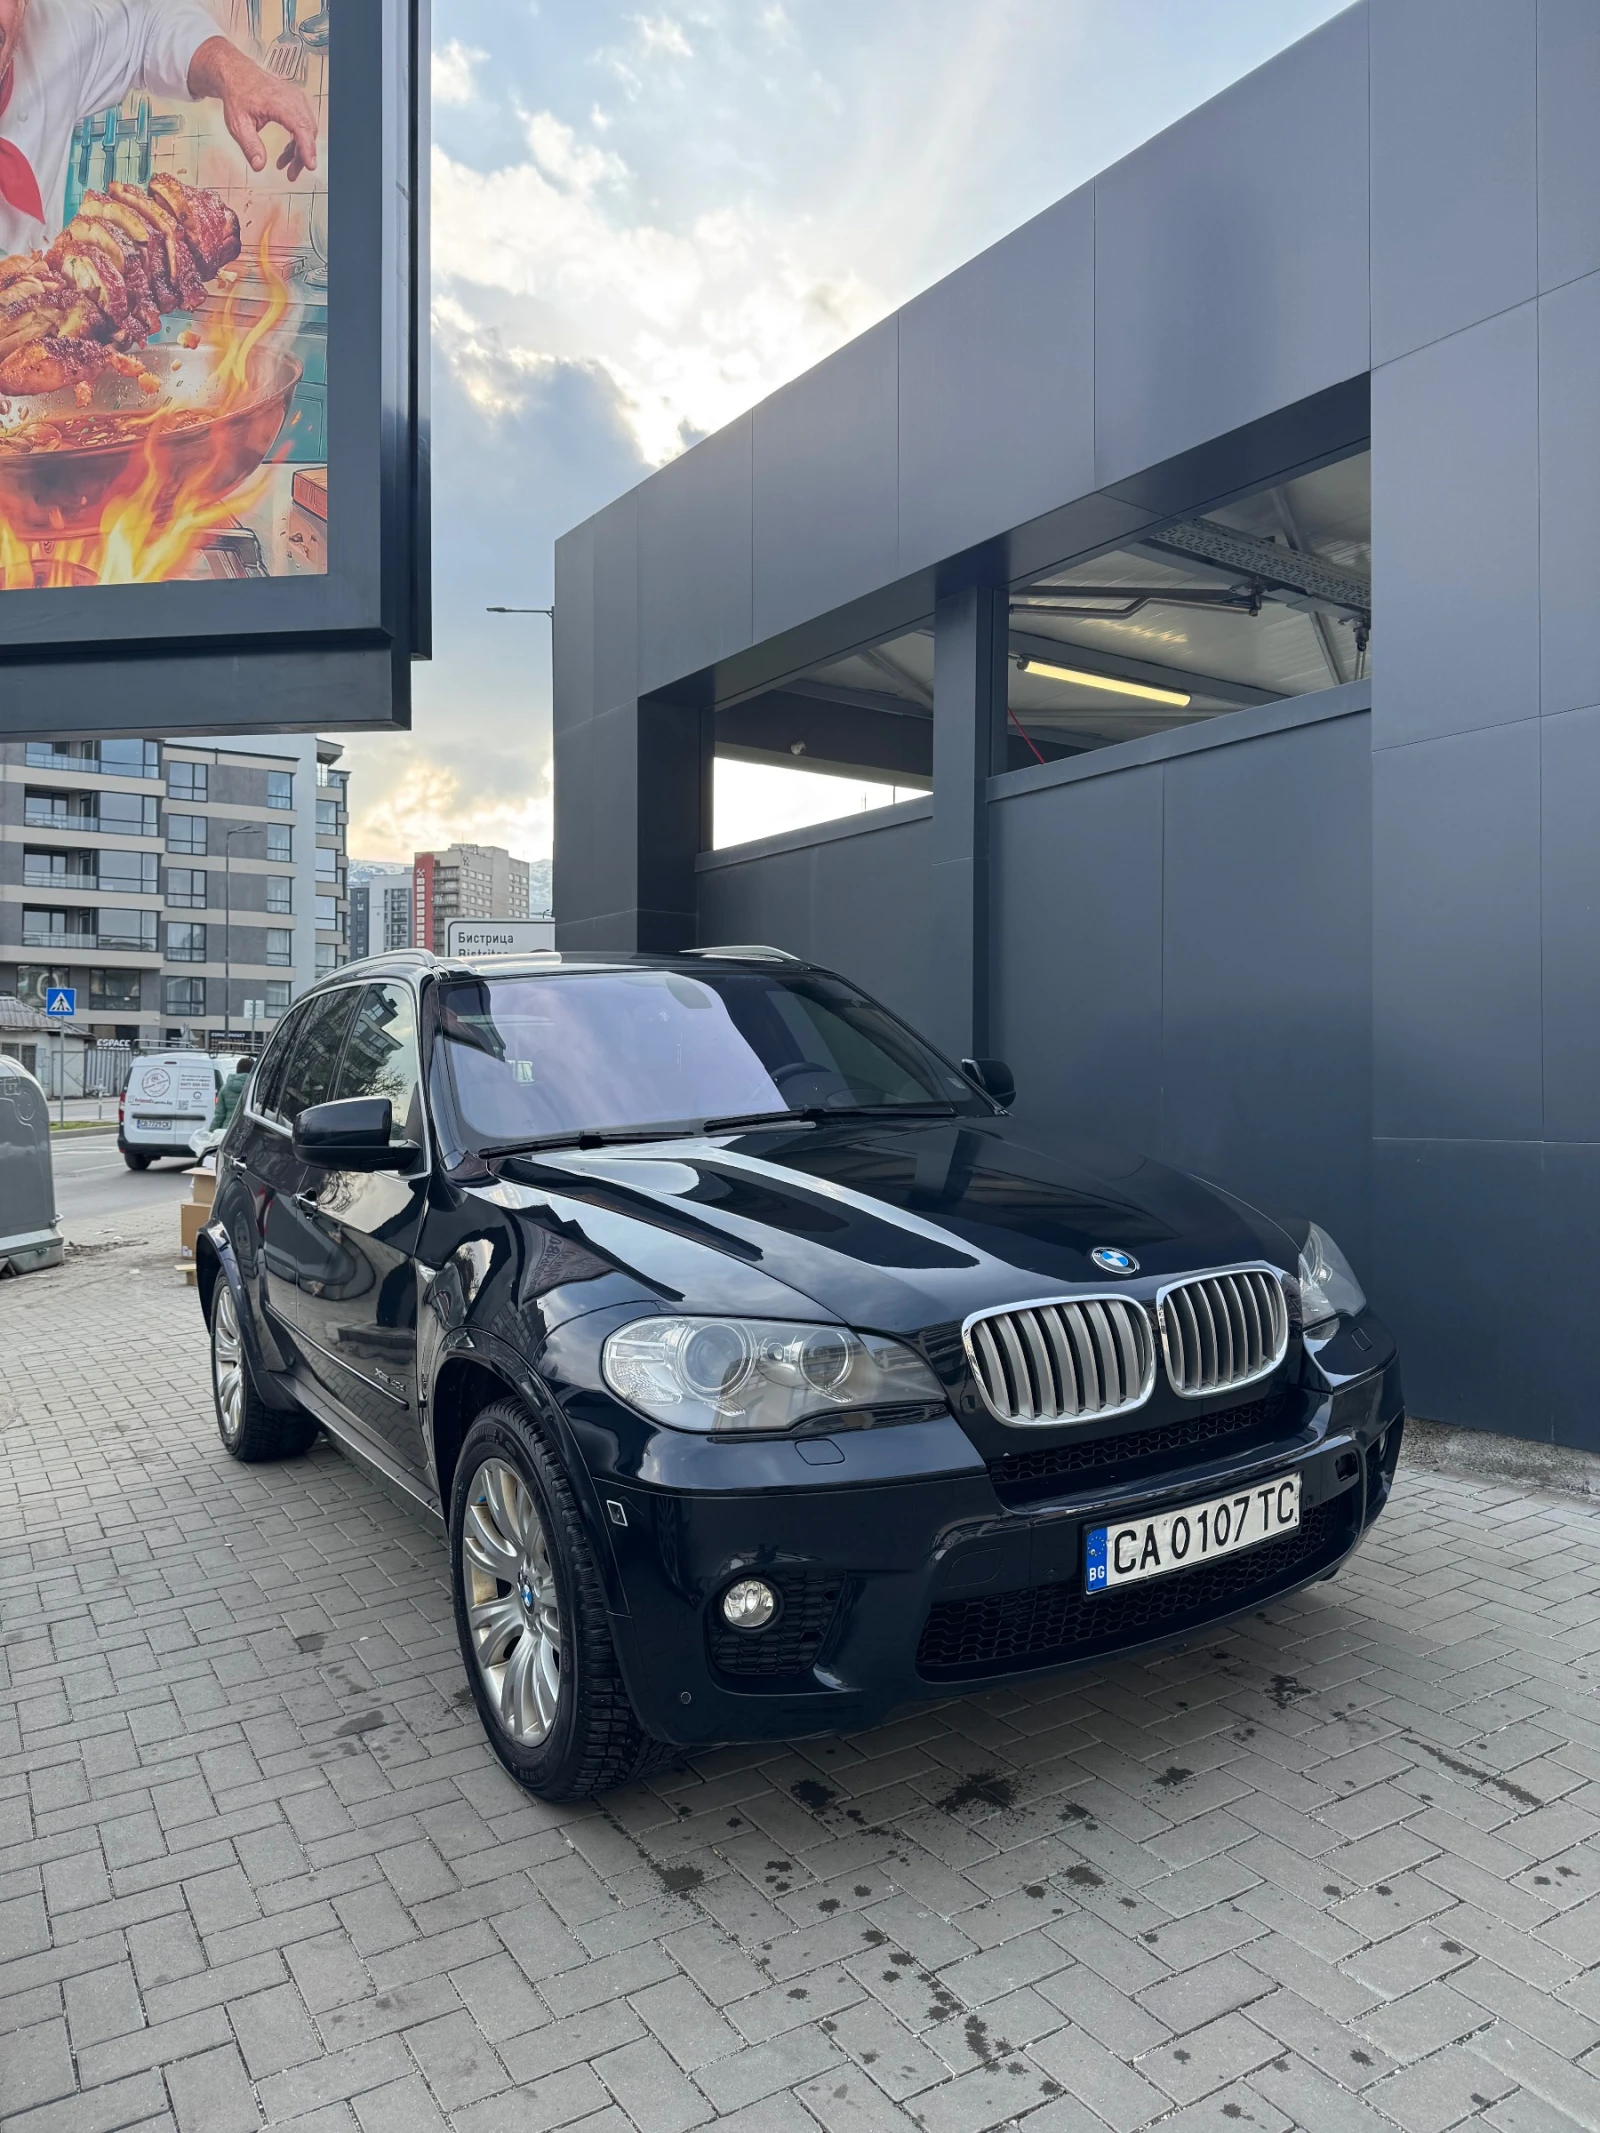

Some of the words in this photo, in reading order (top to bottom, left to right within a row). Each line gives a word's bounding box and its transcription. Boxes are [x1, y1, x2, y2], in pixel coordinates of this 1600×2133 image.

[458, 932, 514, 946] Бистрица
[458, 948, 509, 957] Bistrit
[1089, 1565, 1105, 1582] BG
